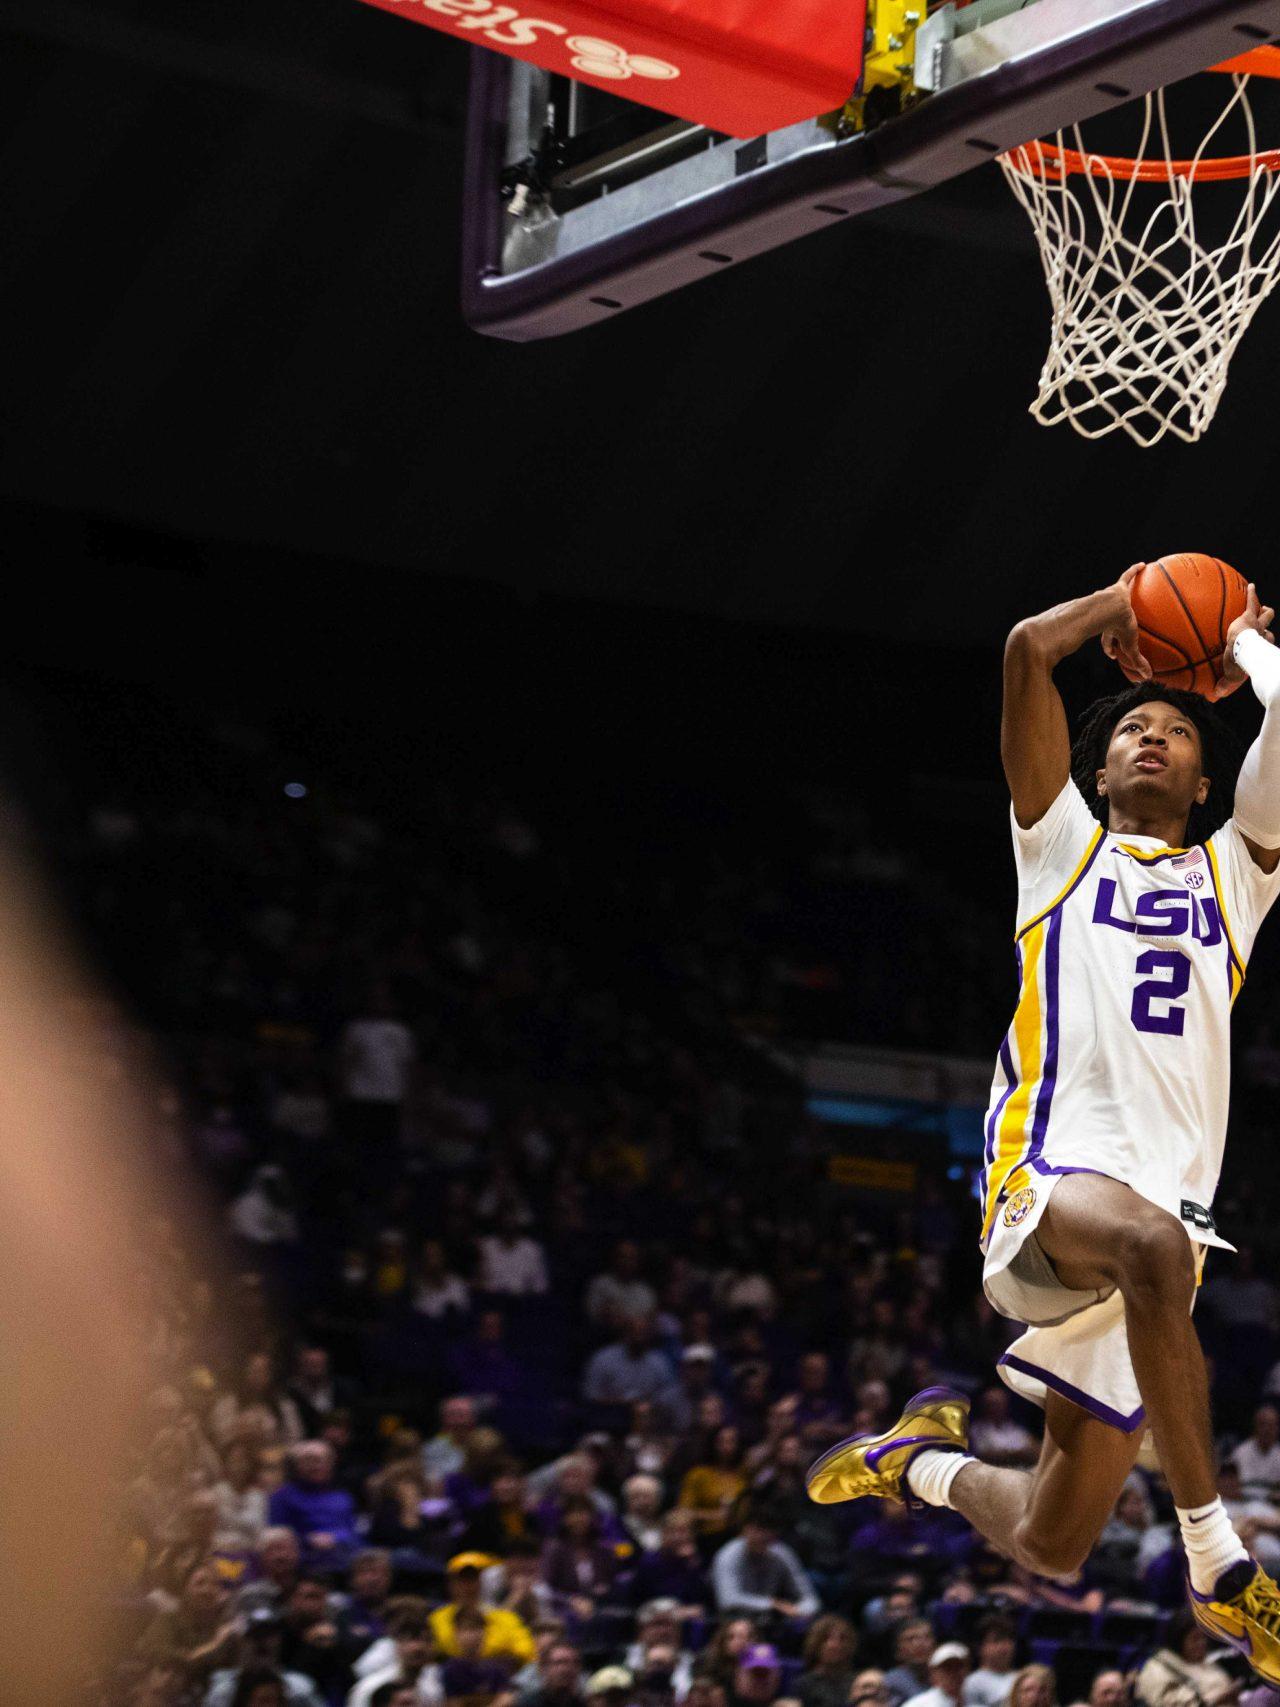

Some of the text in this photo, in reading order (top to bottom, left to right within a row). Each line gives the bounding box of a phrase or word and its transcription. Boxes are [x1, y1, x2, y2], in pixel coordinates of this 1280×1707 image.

[392, 0, 568, 45] Sta
[1185, 872, 1203, 889] SEC
[1092, 878, 1222, 947] LSU
[1130, 950, 1191, 1037] 2
